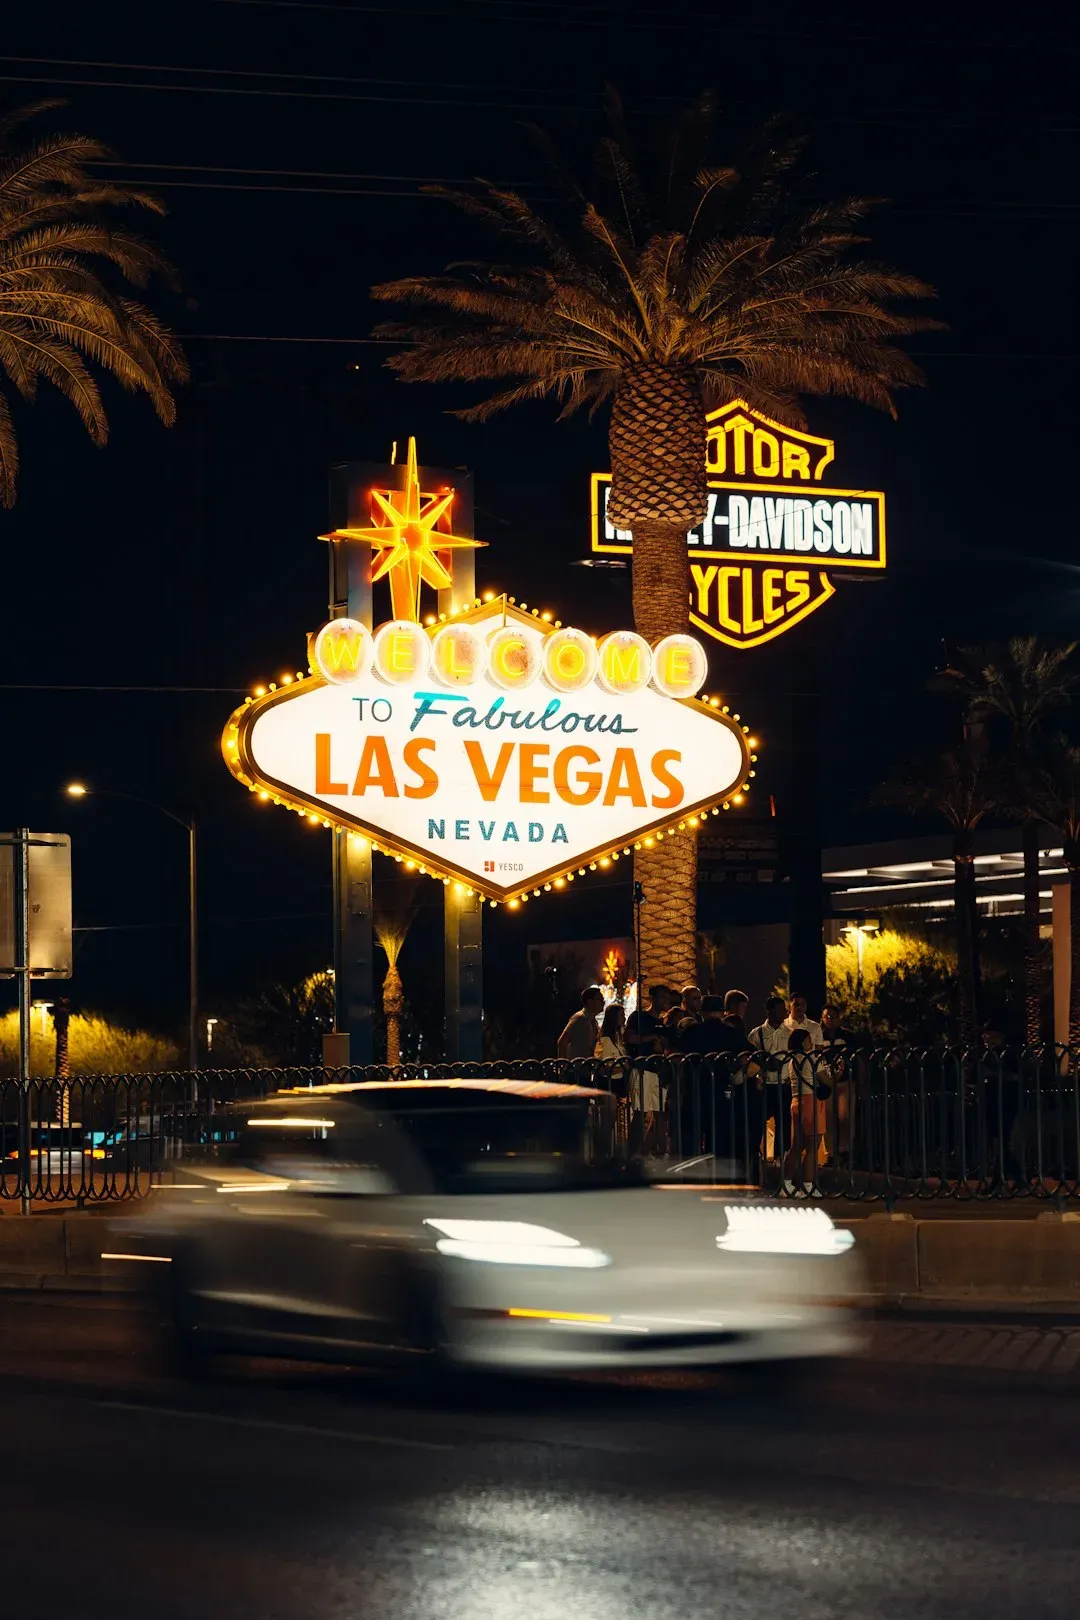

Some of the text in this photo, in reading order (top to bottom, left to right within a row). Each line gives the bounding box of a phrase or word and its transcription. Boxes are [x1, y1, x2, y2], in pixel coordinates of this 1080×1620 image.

[704, 414, 810, 480] OTOR
[605, 487, 873, 555] Y-DAVIDSON
[689, 564, 810, 634] YCLES
[322, 632, 693, 686] WELCOME
[352, 691, 638, 734] TO Fabulous
[315, 733, 685, 809] LAS VEGAS
[427, 818, 569, 844] NEVADA
[498, 862, 524, 872] YESCO
